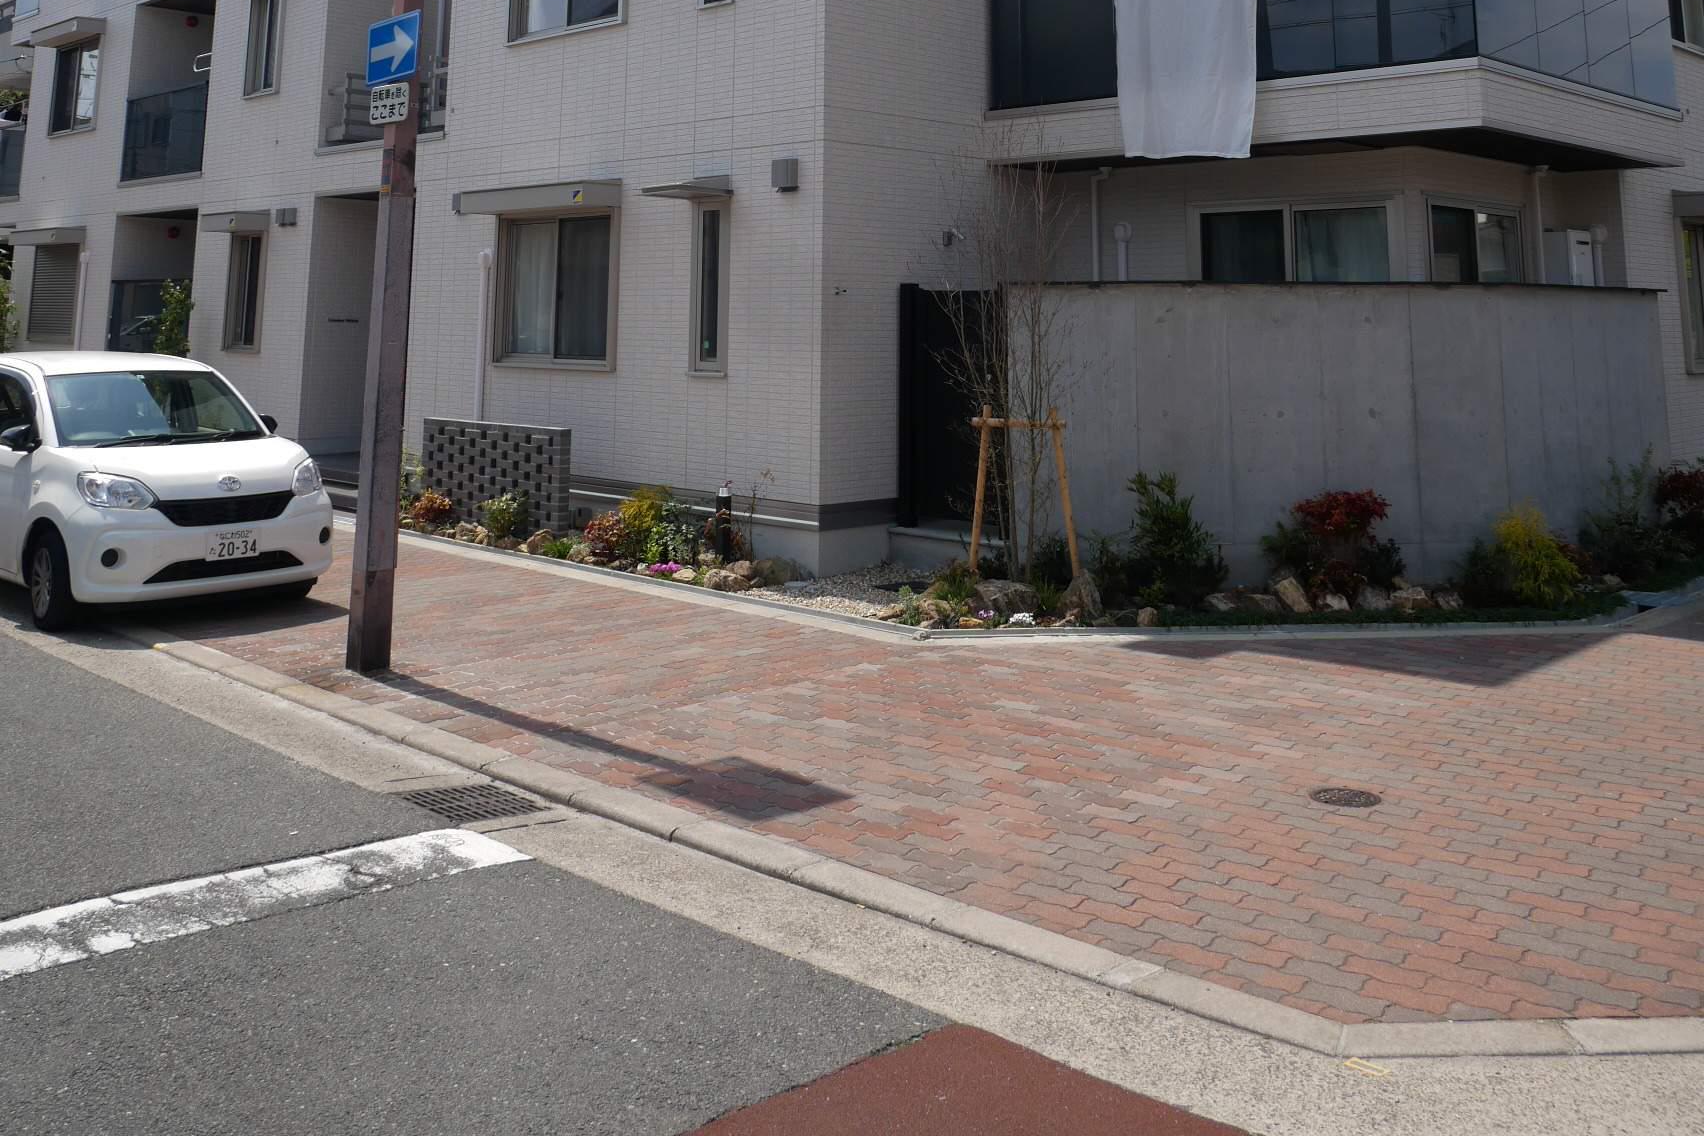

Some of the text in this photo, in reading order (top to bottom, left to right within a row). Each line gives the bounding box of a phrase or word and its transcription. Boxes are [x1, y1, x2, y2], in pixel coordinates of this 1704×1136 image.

[371, 101, 405, 120] ここまで
[218, 538, 257, 558] 20-34
